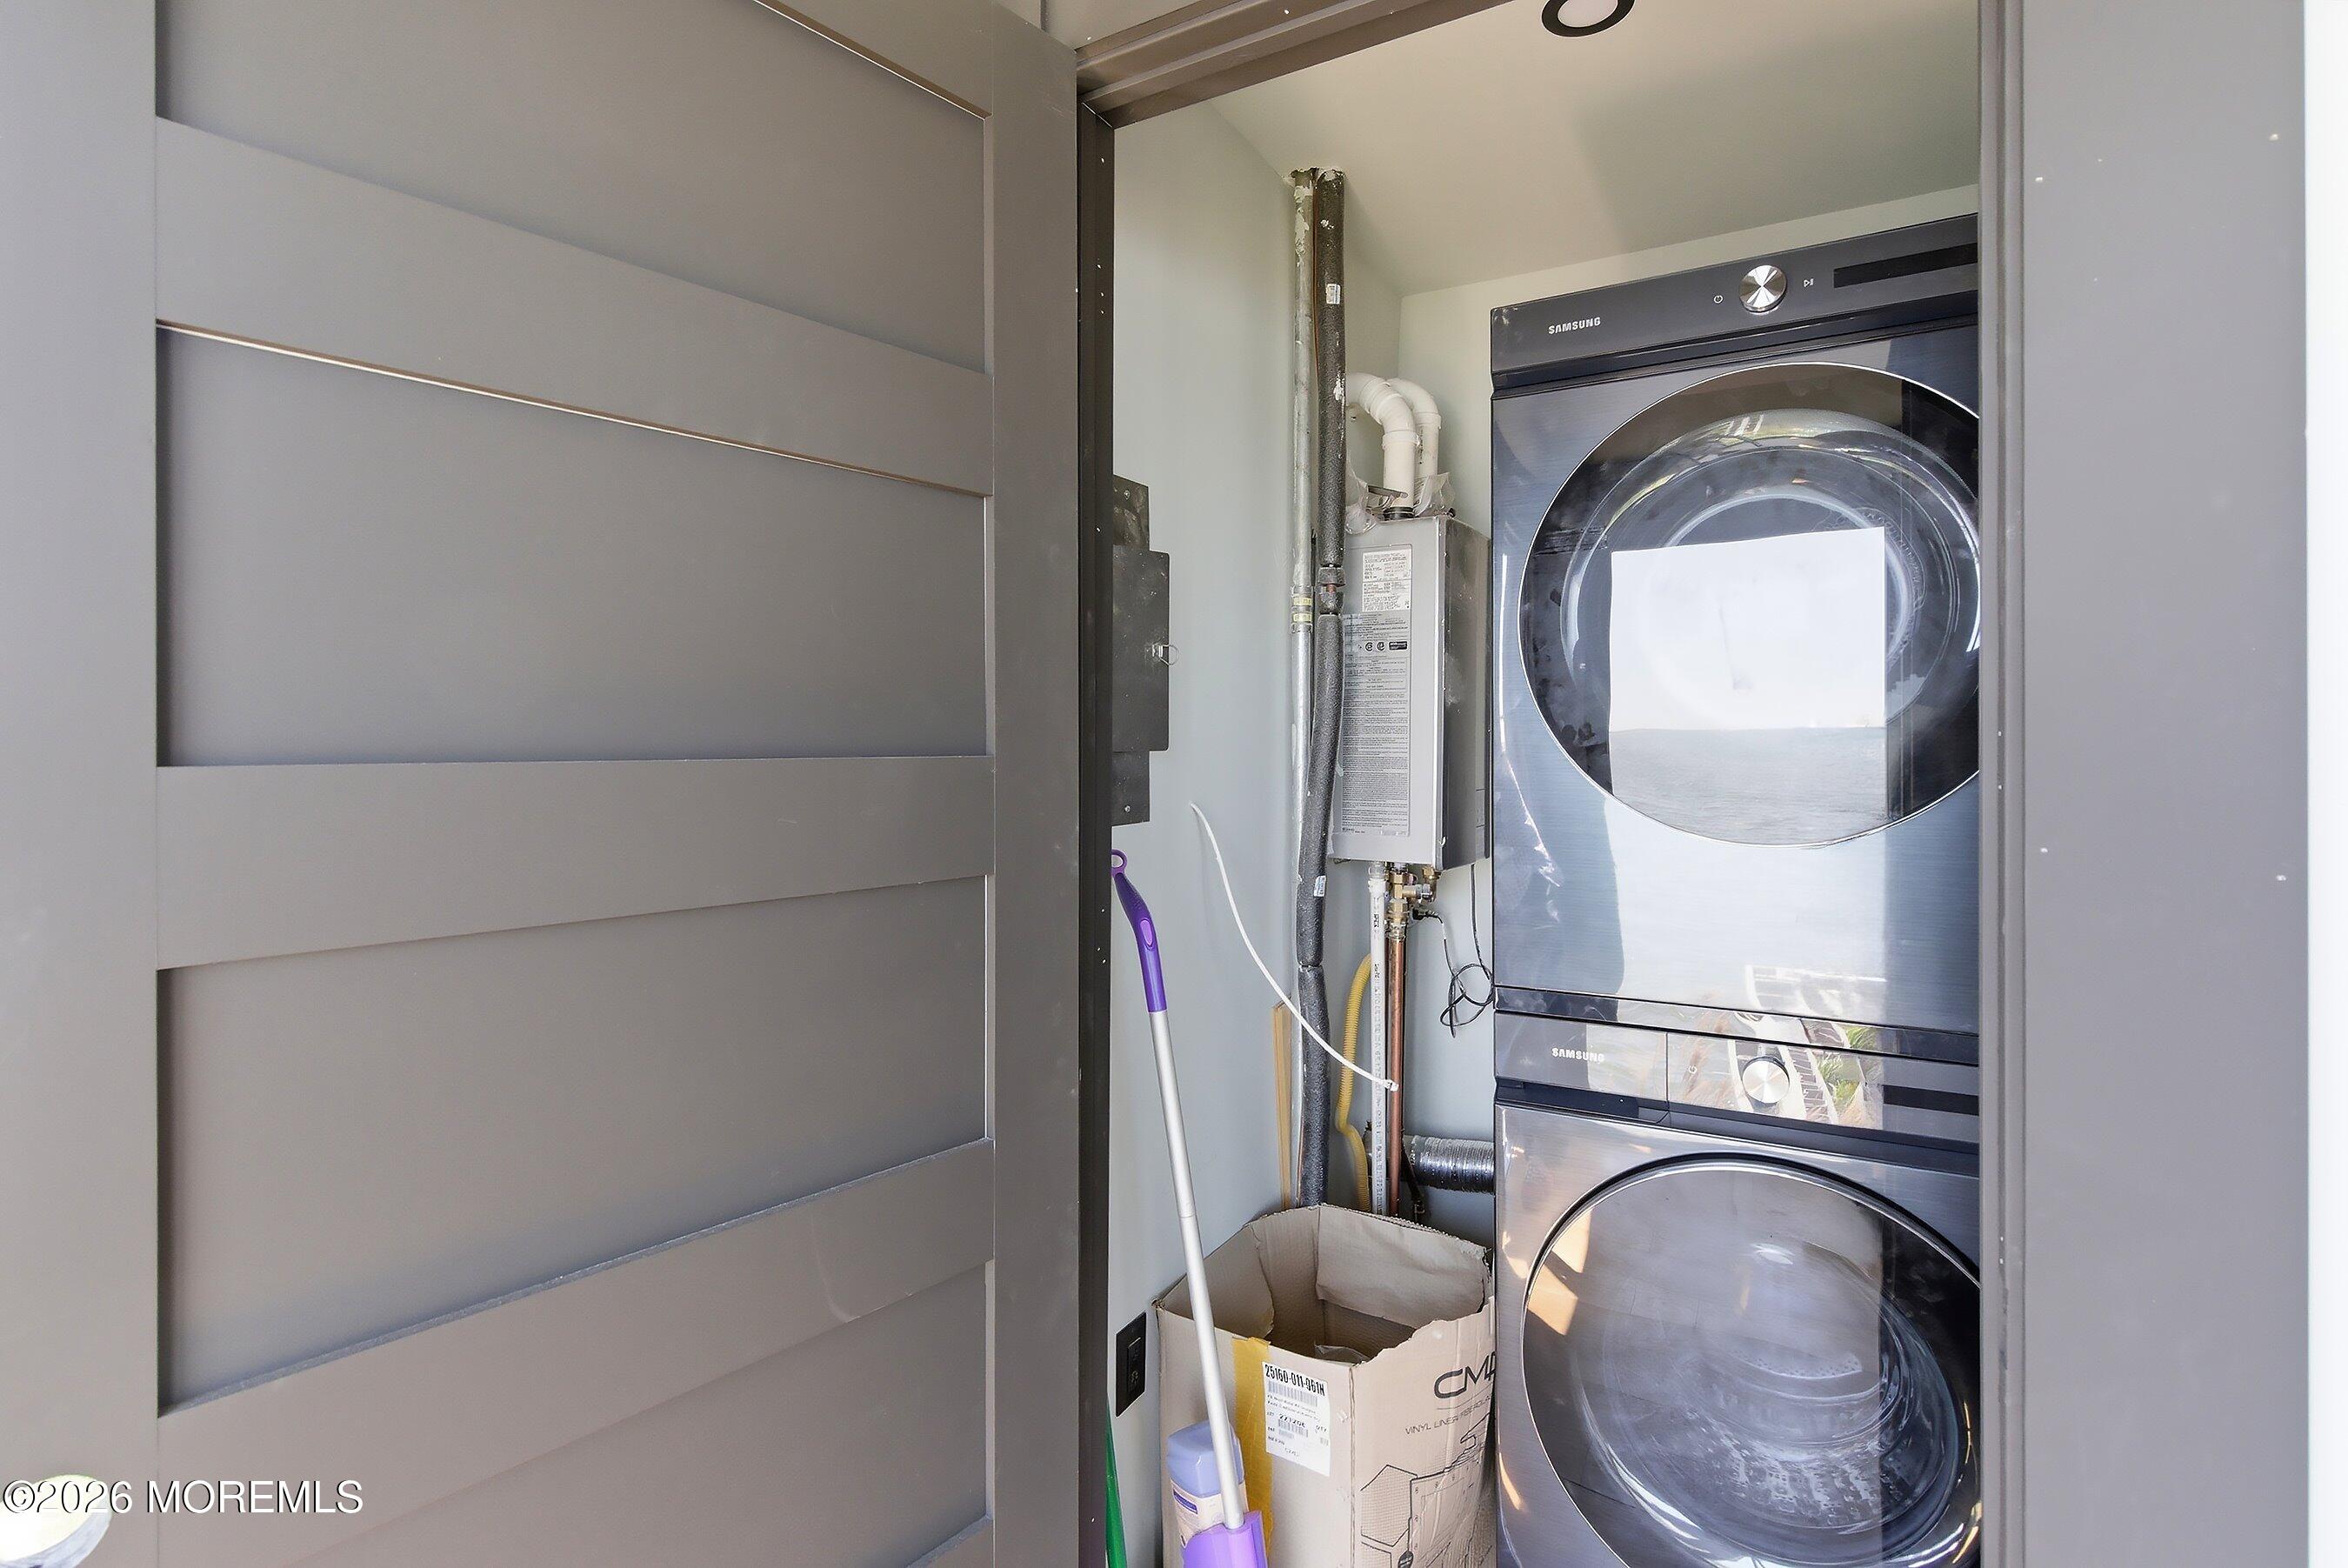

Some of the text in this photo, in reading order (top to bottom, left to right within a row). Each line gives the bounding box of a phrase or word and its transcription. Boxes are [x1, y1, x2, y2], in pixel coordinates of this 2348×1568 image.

[1548, 317, 1601, 335] SAMSUNG
[1551, 1047, 1604, 1063] SAMSUNG
[1405, 1423, 1431, 1435] VINYL
